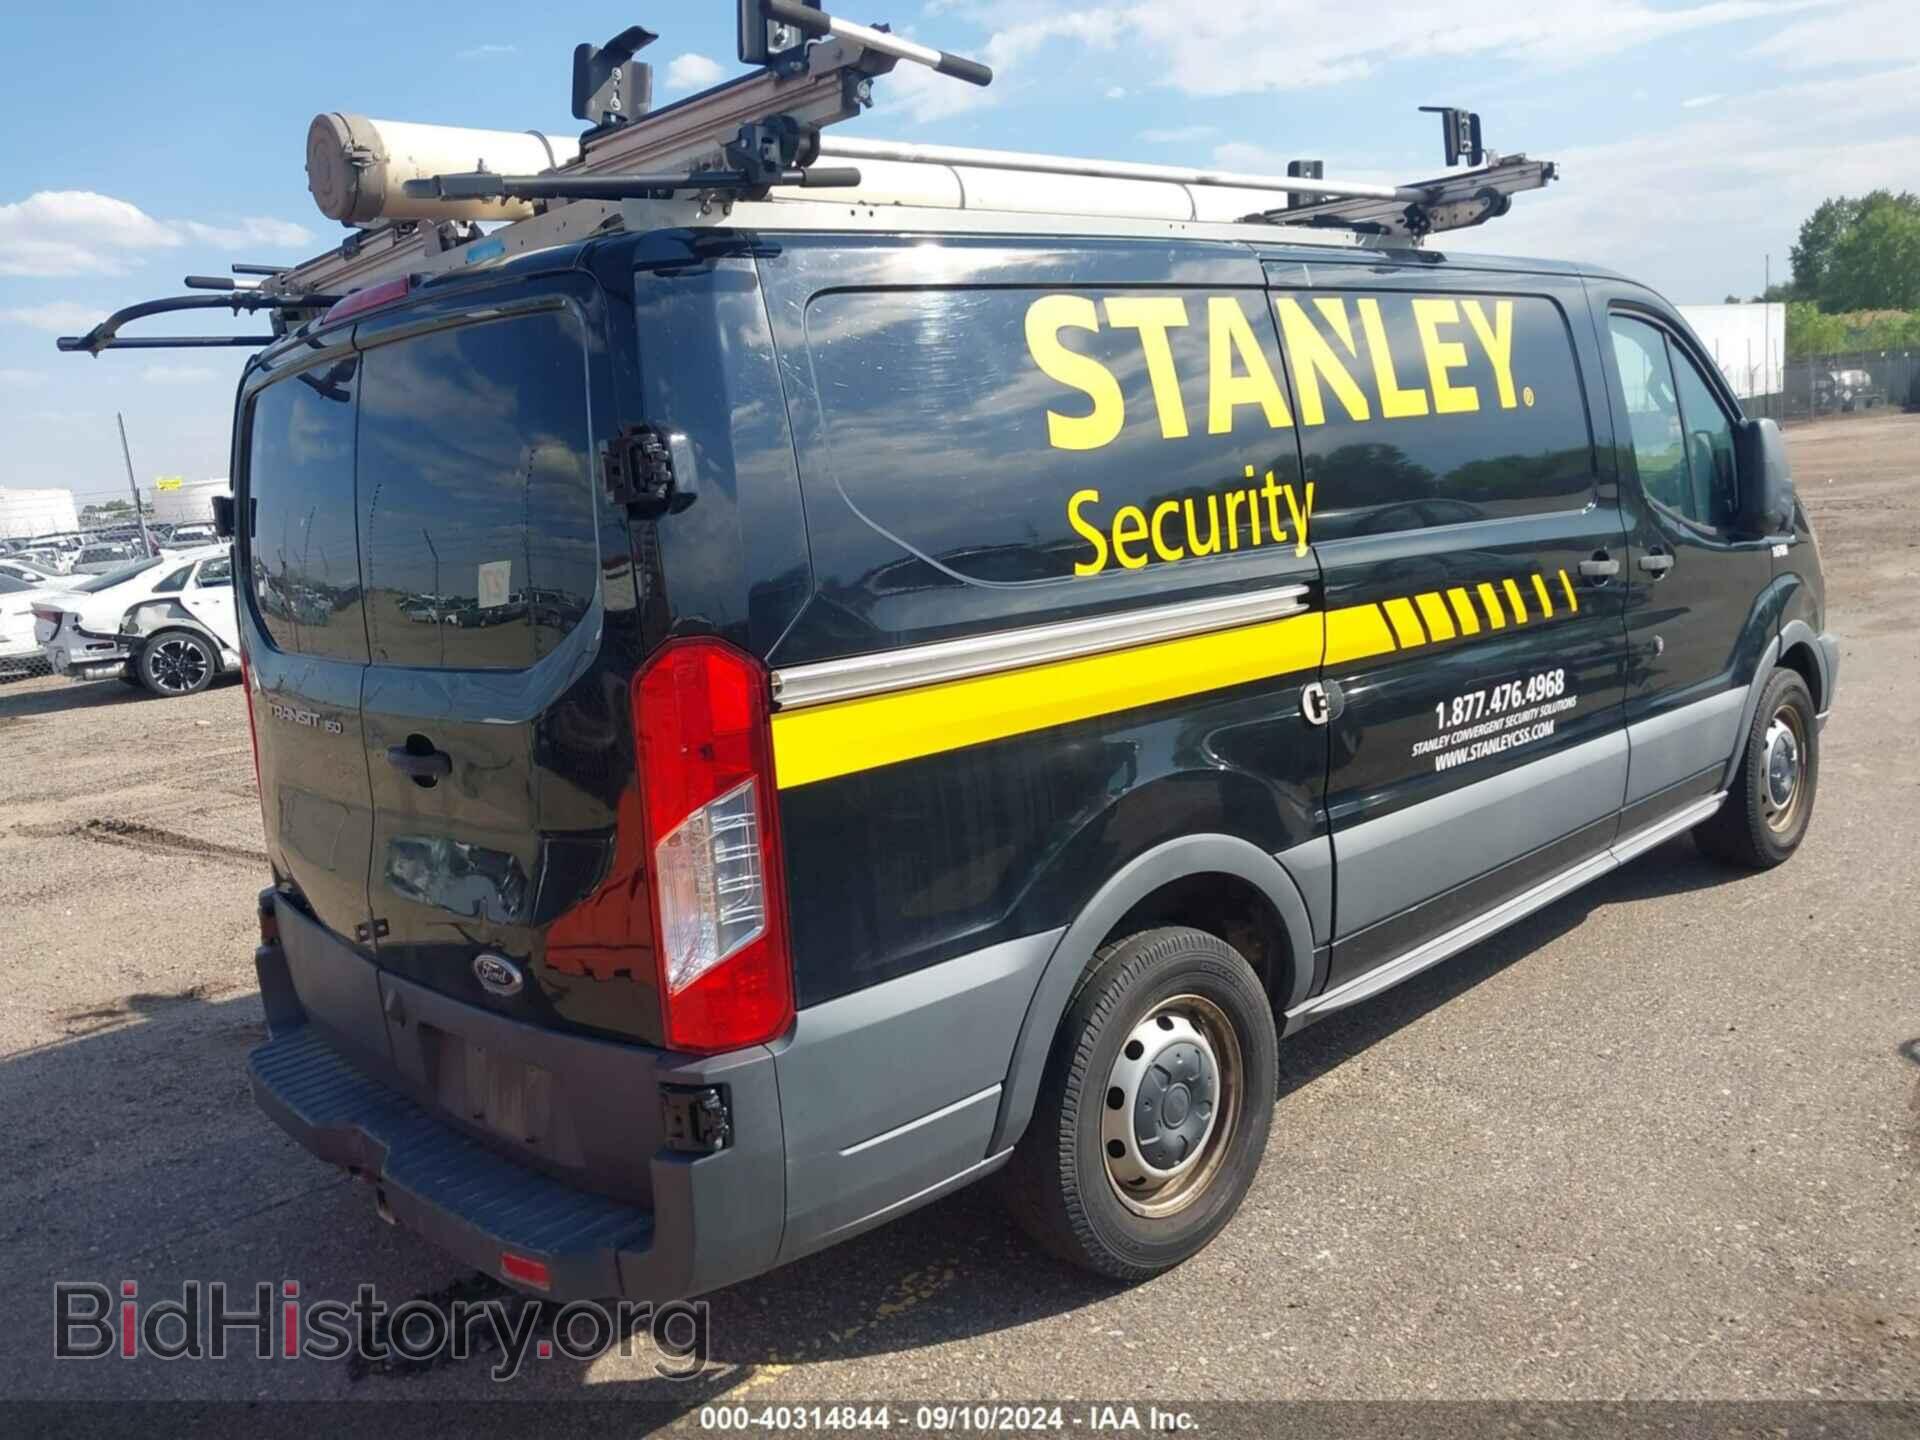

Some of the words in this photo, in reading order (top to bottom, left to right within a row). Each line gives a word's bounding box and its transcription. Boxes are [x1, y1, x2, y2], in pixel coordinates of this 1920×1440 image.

[1024, 294, 1518, 450] STANLEY
[1067, 464, 1315, 577] Security
[267, 702, 321, 728] TRANSIT
[1411, 734, 1451, 758] STANLEY
[1451, 718, 1505, 745] CONVERGENT
[1504, 706, 1540, 729] SECURITY
[1540, 695, 1577, 718] SOLUTIONS
[1436, 668, 1564, 731] 1.877.476.4968
[1435, 719, 1555, 772] WWW.STANLEYCSS.COM
